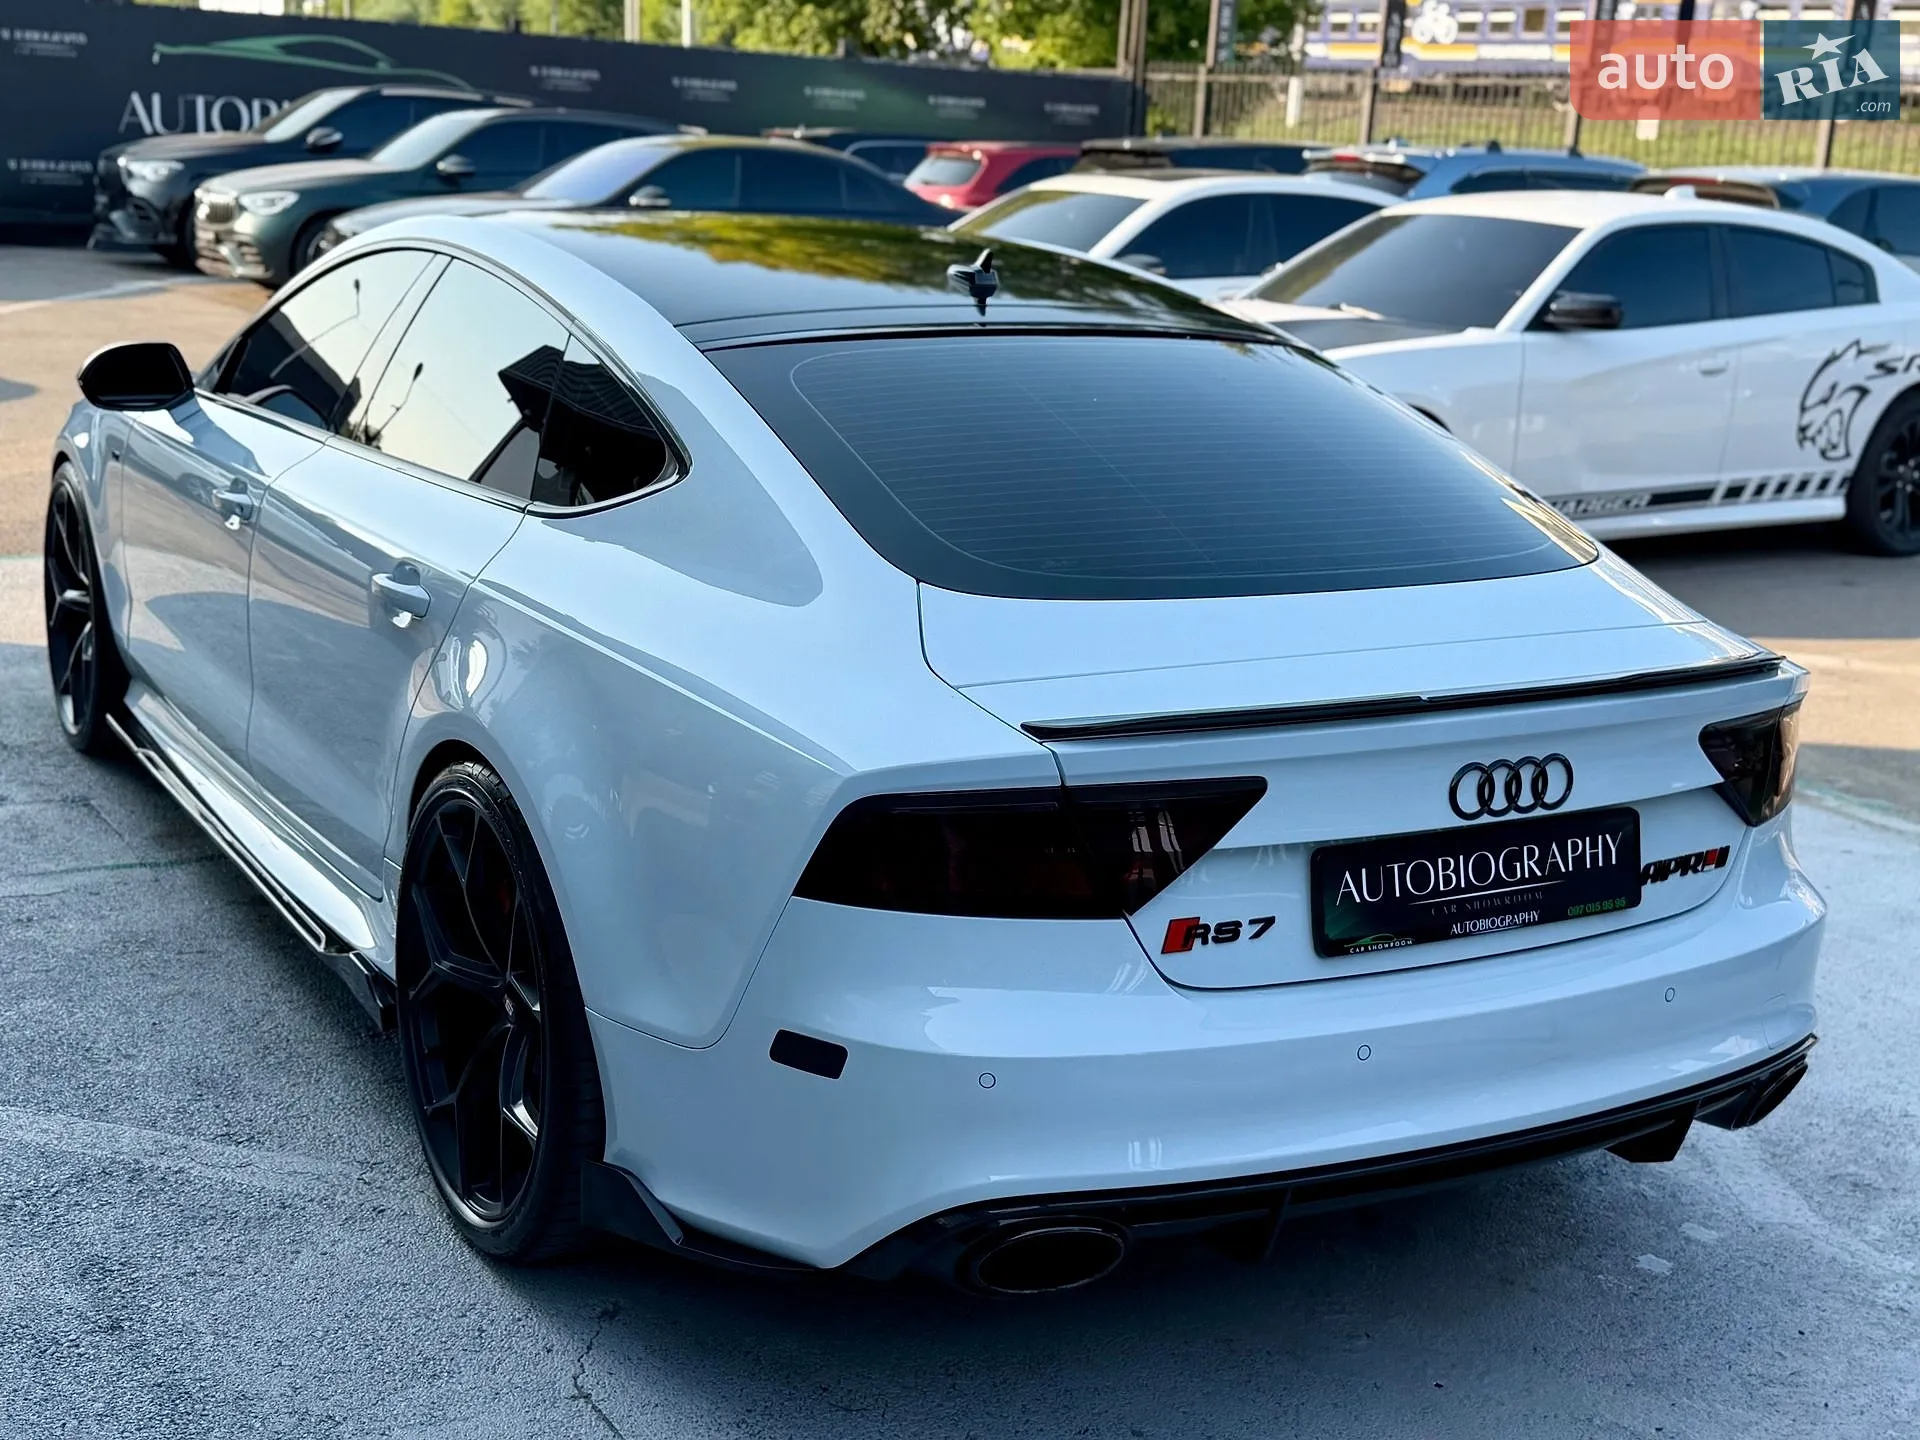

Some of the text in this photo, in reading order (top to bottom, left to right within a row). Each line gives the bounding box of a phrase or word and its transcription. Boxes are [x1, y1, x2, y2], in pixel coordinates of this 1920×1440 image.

[1336, 832, 1622, 906] AUTOBIOGRAPHY
[1450, 909, 1541, 936] AUTOBIOGRAPHY
[1349, 939, 1413, 954] CAR SHOWROOM
